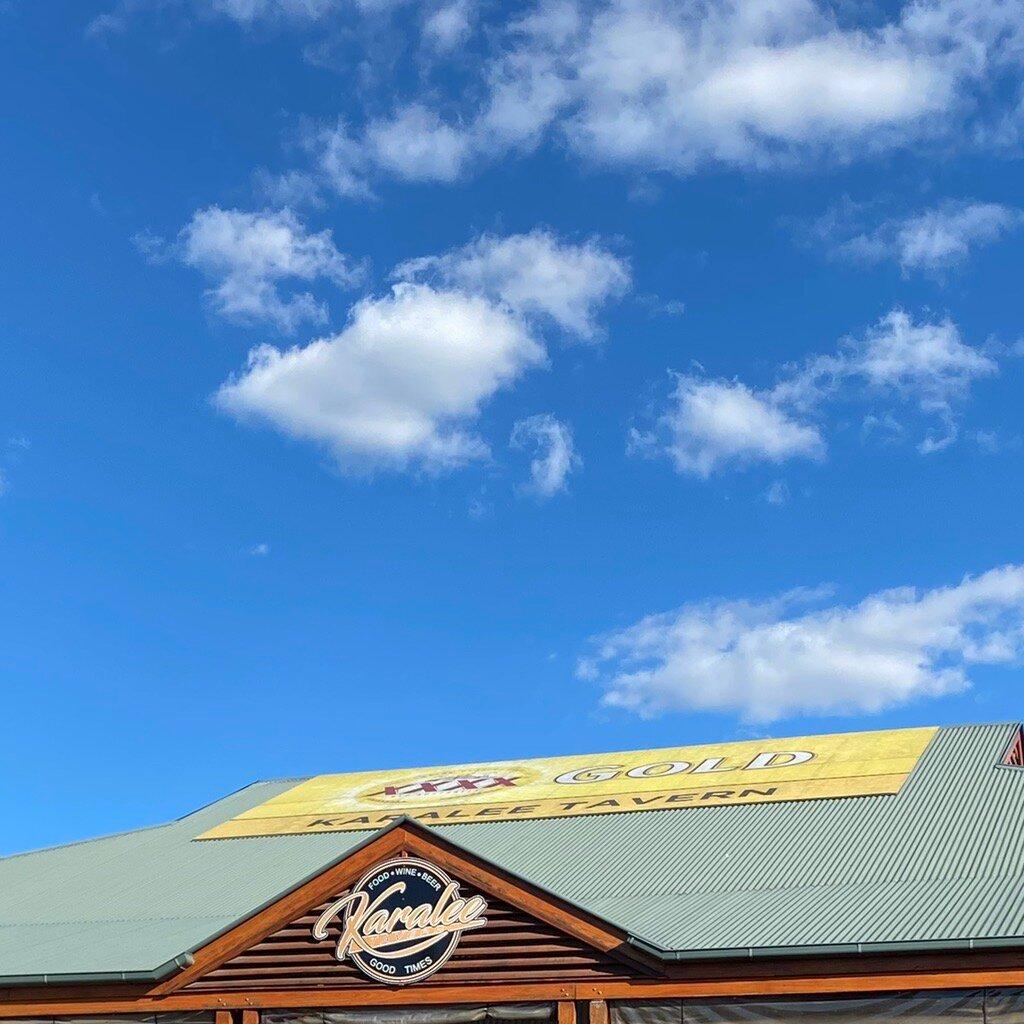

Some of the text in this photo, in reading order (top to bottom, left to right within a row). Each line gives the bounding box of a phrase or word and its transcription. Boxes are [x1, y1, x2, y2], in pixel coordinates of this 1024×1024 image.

[554, 750, 818, 785] GOLD
[306, 787, 778, 828] KARALEE TAVERN
[367, 867, 442, 892] FOOD WINE BEER
[313, 880, 488, 961] Karalee
[369, 956, 433, 974] GOOD TIMES
